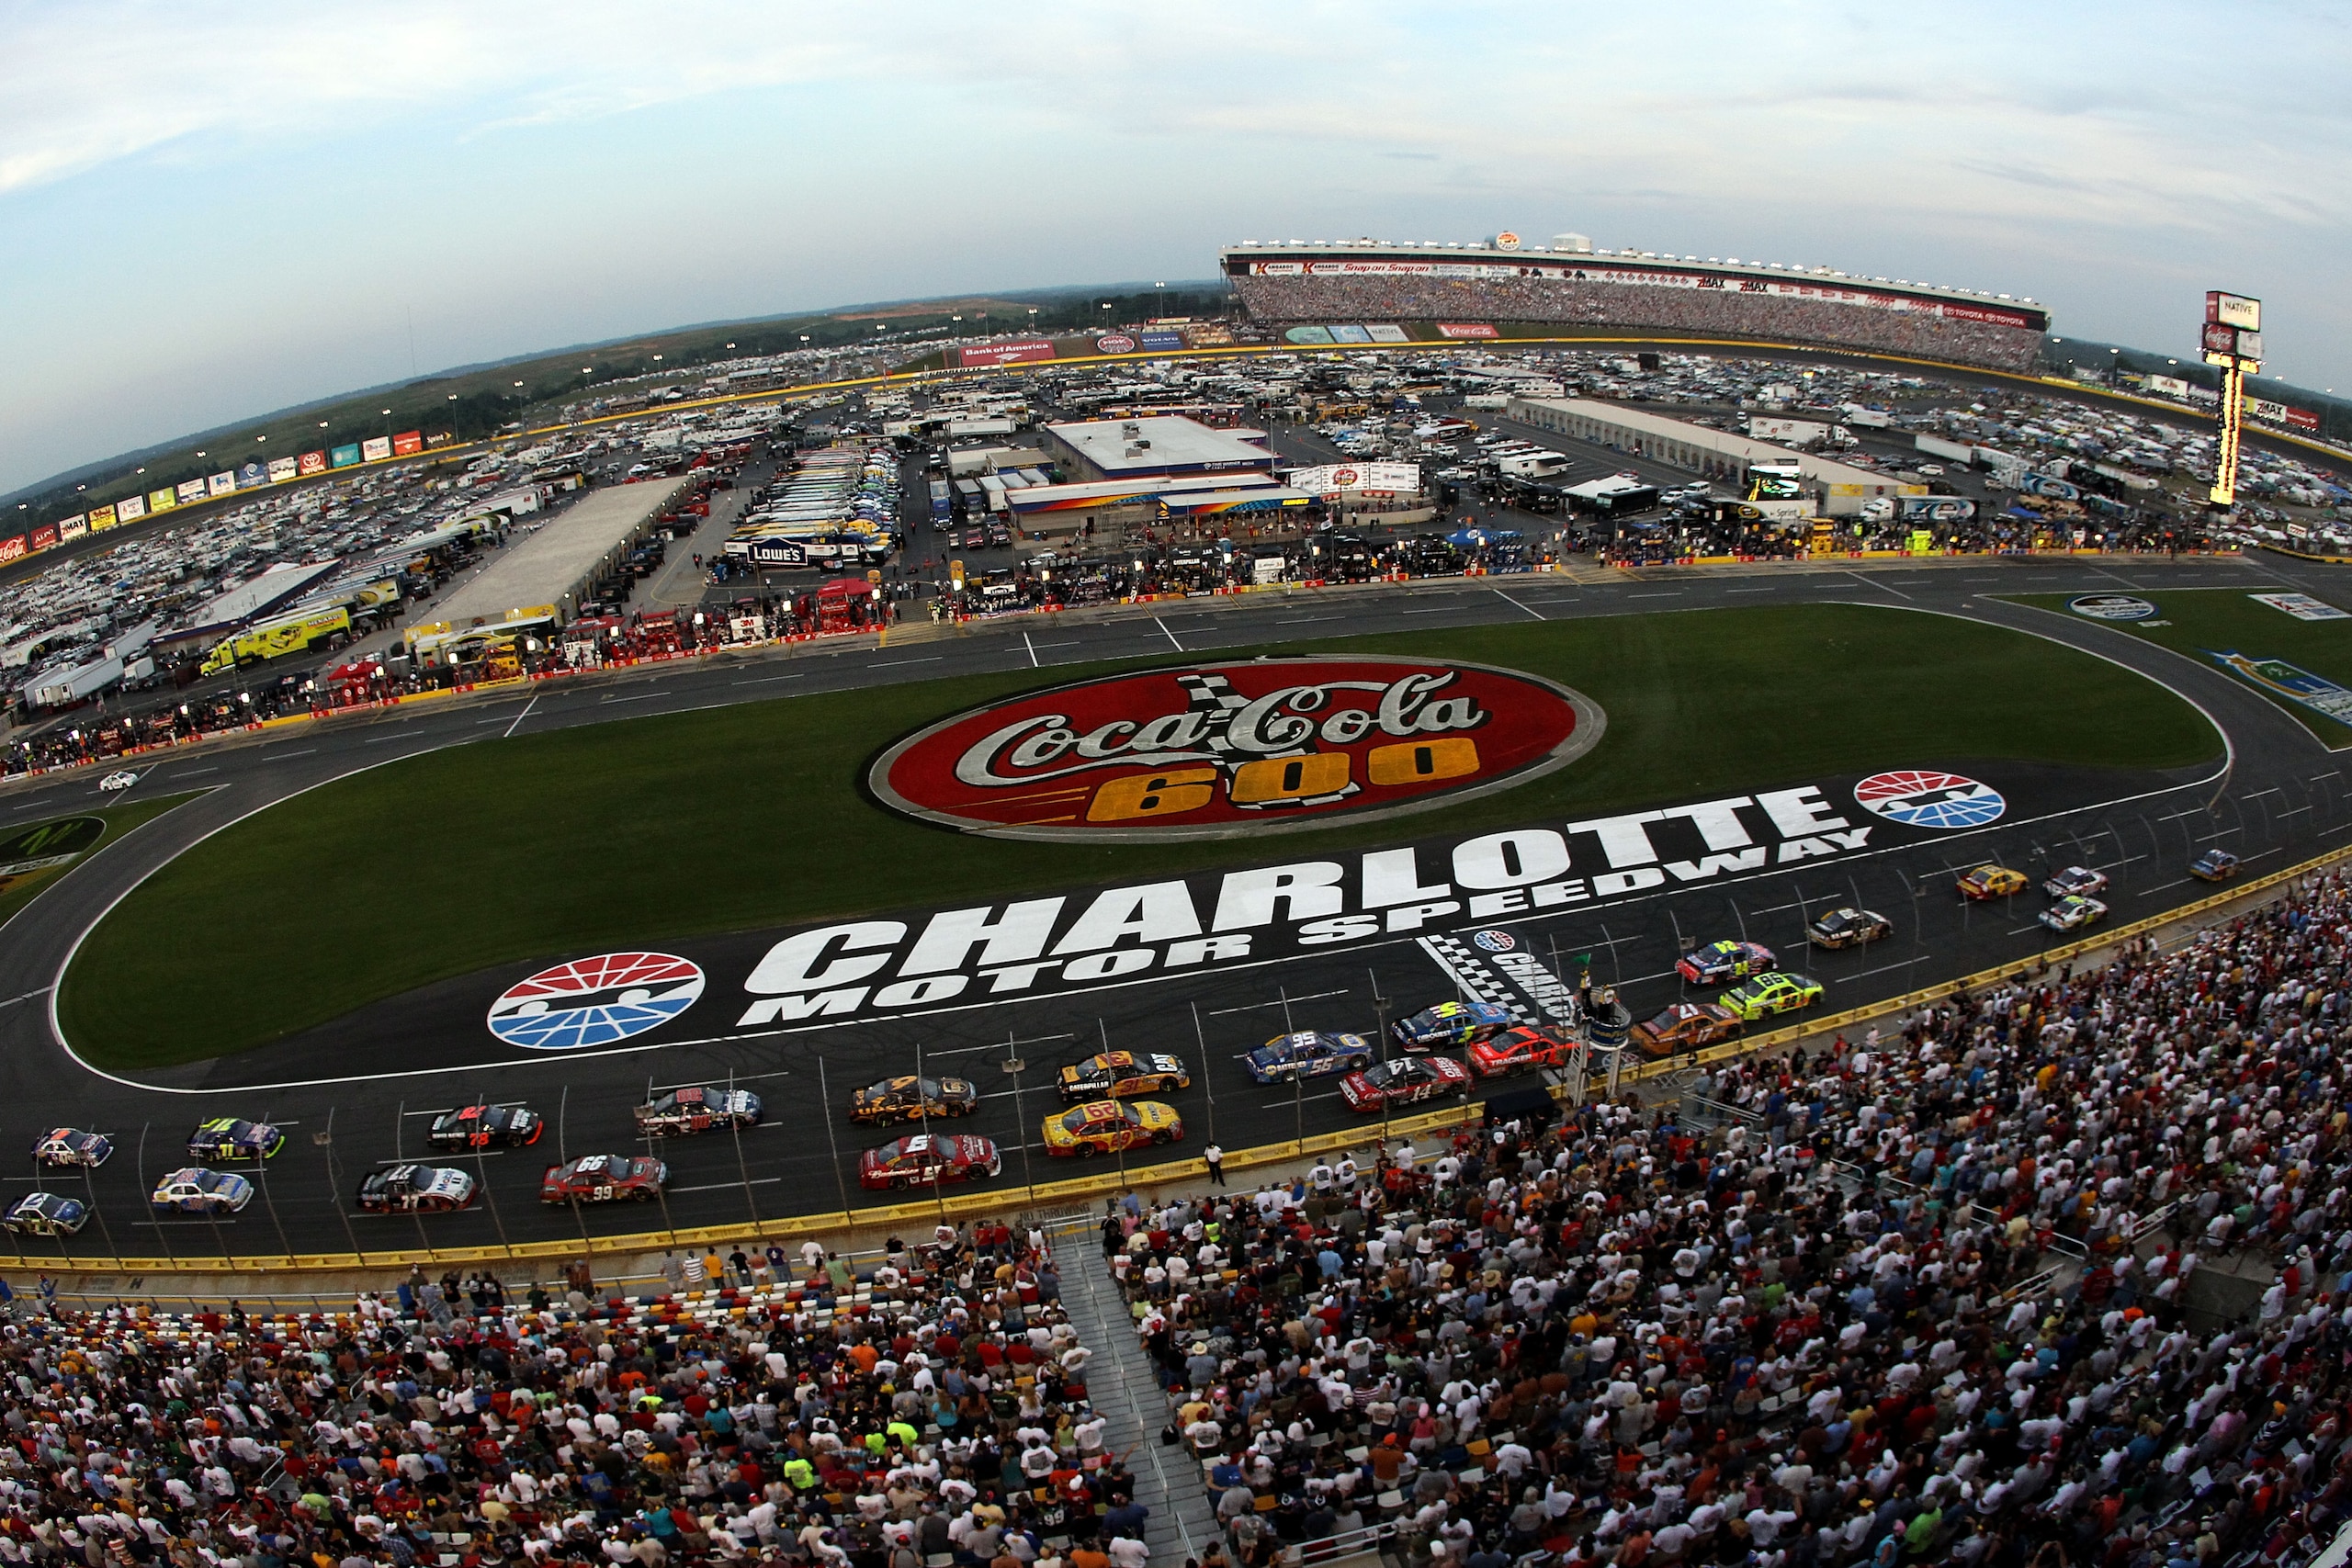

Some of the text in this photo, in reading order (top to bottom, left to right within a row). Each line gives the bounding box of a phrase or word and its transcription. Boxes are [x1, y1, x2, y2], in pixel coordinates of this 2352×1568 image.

[1954, 309, 1984, 321] TOYOTA
[2224, 301, 2253, 315] NATIVE
[1996, 315, 2025, 326] TOYOTA
[1451, 327, 1492, 336] Coca-Cola
[965, 348, 992, 356] Bank
[1004, 343, 1049, 352] America
[425, 434, 445, 445] Sprint
[301, 465, 326, 476] TOYOTA
[1282, 498, 1310, 506] SUNOCO
[1776, 508, 1797, 519] Sprint
[35, 528, 54, 544] ALPO
[753, 547, 801, 562] LOWE'S
[1172, 558, 1201, 566] CATERPILLAR
[740, 618, 754, 627] 3M
[565, 644, 574, 652] 21
[956, 671, 1486, 787] Coca-Cola
[1084, 737, 1480, 822] 600
[743, 785, 1849, 995] CHARLOTTE
[735, 826, 1872, 1027] MOTOR SPEEDWAY
[1695, 1027, 1714, 1043] 17
[1308, 1057, 1333, 1075] 56
[1387, 1056, 1416, 1075] 14
[1491, 1054, 1532, 1066] TRACKER
[1069, 1081, 1109, 1092] CATERPILLAR
[1120, 1078, 1141, 1093] 31
[1410, 1084, 1432, 1102] 14
[469, 1132, 490, 1146] 78
[1110, 1132, 1131, 1147] 29
[219, 1143, 234, 1157] 11
[436, 1170, 456, 1191] Mobil
[868, 1168, 920, 1179] Budweiser
[594, 1185, 613, 1201] 99
